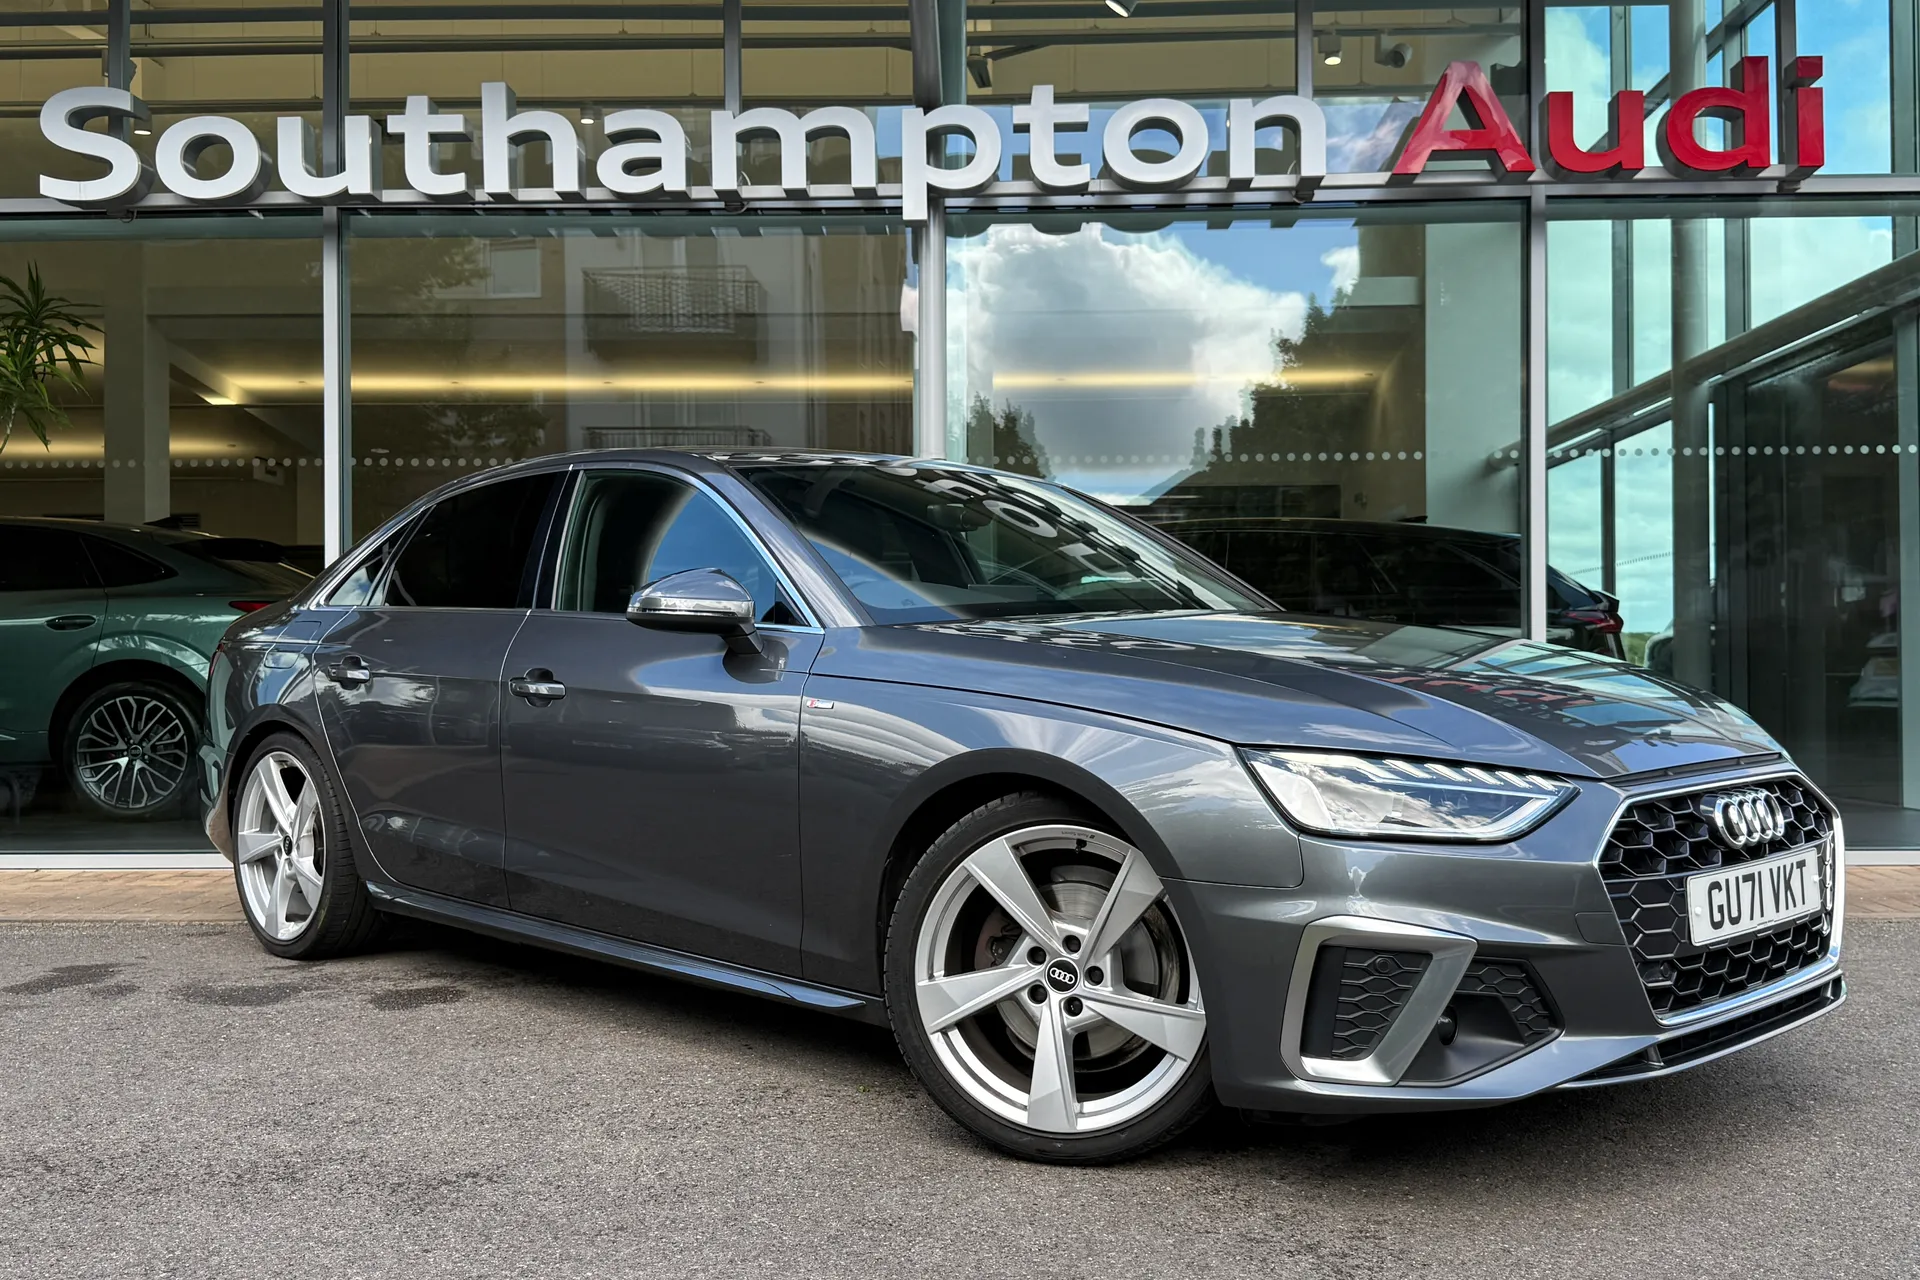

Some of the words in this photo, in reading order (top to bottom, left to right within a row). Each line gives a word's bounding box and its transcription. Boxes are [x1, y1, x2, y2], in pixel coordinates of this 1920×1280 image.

[39, 82, 1326, 220] Southampton
[1393, 55, 1824, 178] Audi
[1707, 870, 1764, 931] GU71
[1769, 859, 1806, 914] VKT
